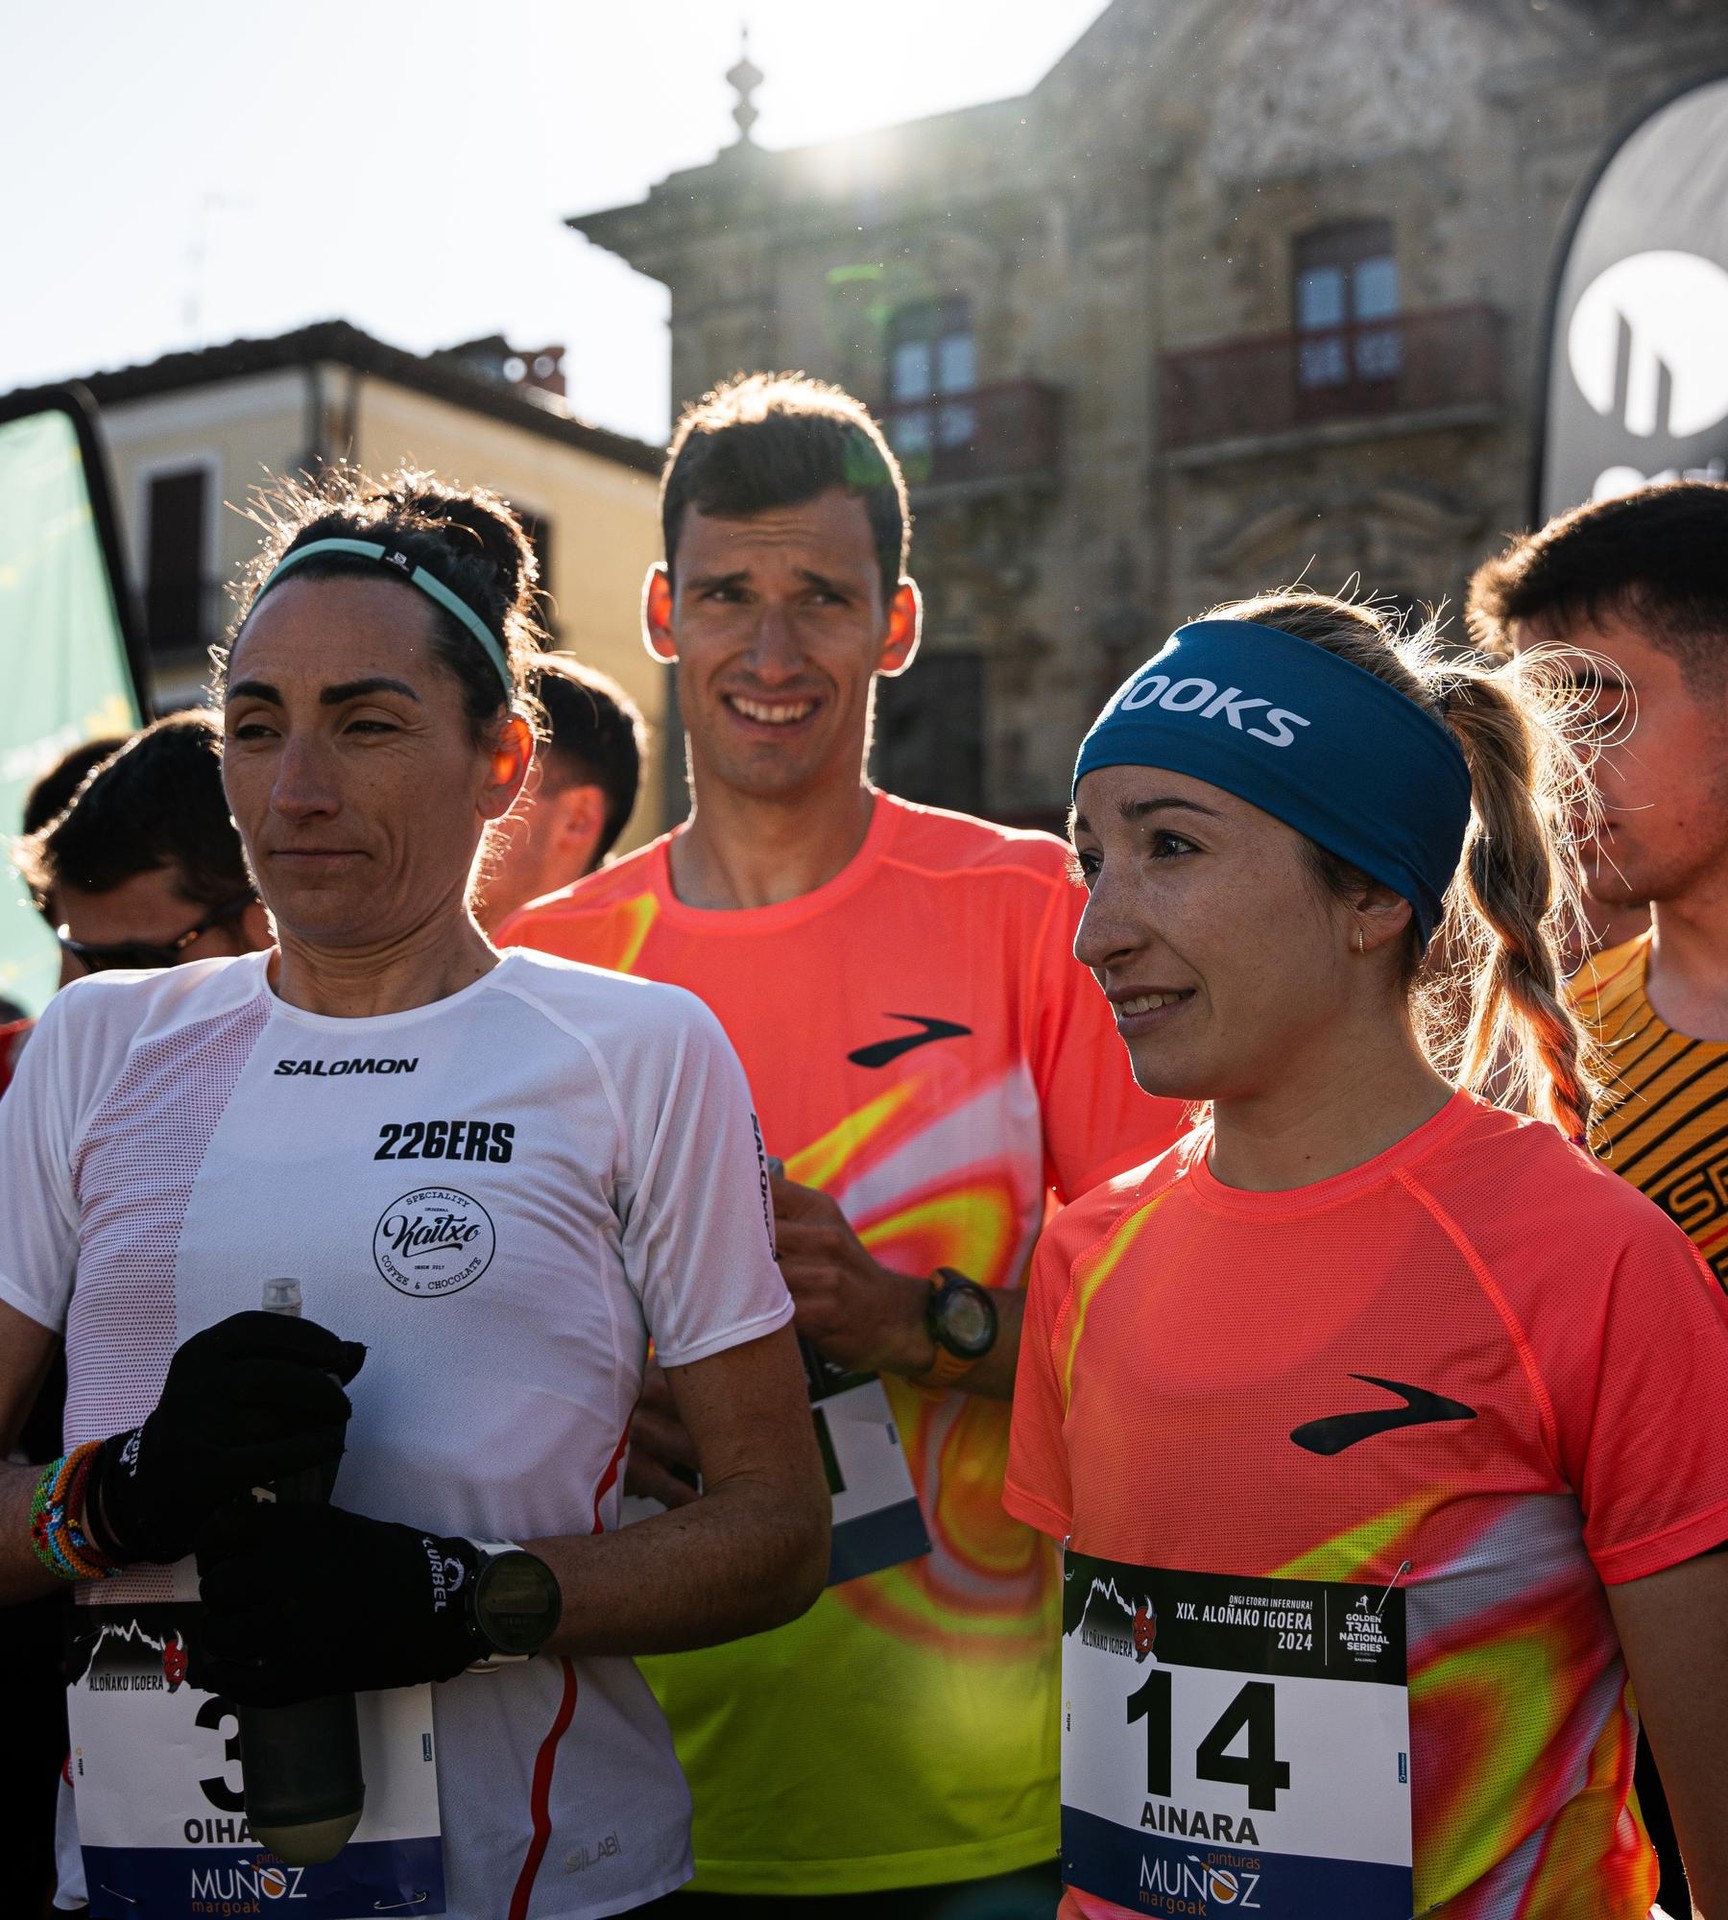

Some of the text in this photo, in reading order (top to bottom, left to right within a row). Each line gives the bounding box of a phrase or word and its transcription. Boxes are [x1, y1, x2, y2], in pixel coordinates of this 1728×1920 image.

[1120, 674, 1312, 748] OOKS
[273, 1057, 420, 1077] SALOMON
[373, 1120, 516, 1164] 226ERS
[405, 1191, 471, 1208] SPECIALITY
[382, 1213, 482, 1258] Kaitxo
[381, 1254, 410, 1287] COFFEE
[427, 1256, 482, 1291] CHOCOLATE
[1228, 1594, 1245, 1606] ONGI
[1245, 1596, 1269, 1608] ETORRI
[1175, 1602, 1313, 1631] XIX. ALOÑAKO IGOERA
[1345, 1612, 1382, 1624] GOLDEN
[1346, 1621, 1383, 1635] TRAIL
[1277, 1631, 1313, 1651] 2024
[1339, 1632, 1390, 1645] NATIONAL
[1346, 1641, 1382, 1653] SERIES
[89, 1673, 164, 1692] ALOÑAKO IGOERA
[1126, 1668, 1291, 1812] 14
[1140, 1801, 1260, 1846] AINARA
[1207, 1851, 1261, 1870] pinturas
[191, 1859, 308, 1900] MUÑOZ
[1140, 1853, 1261, 1909] MUÑOZ
[192, 1899, 262, 1917] margoak
[1139, 1889, 1207, 1917] margoak
